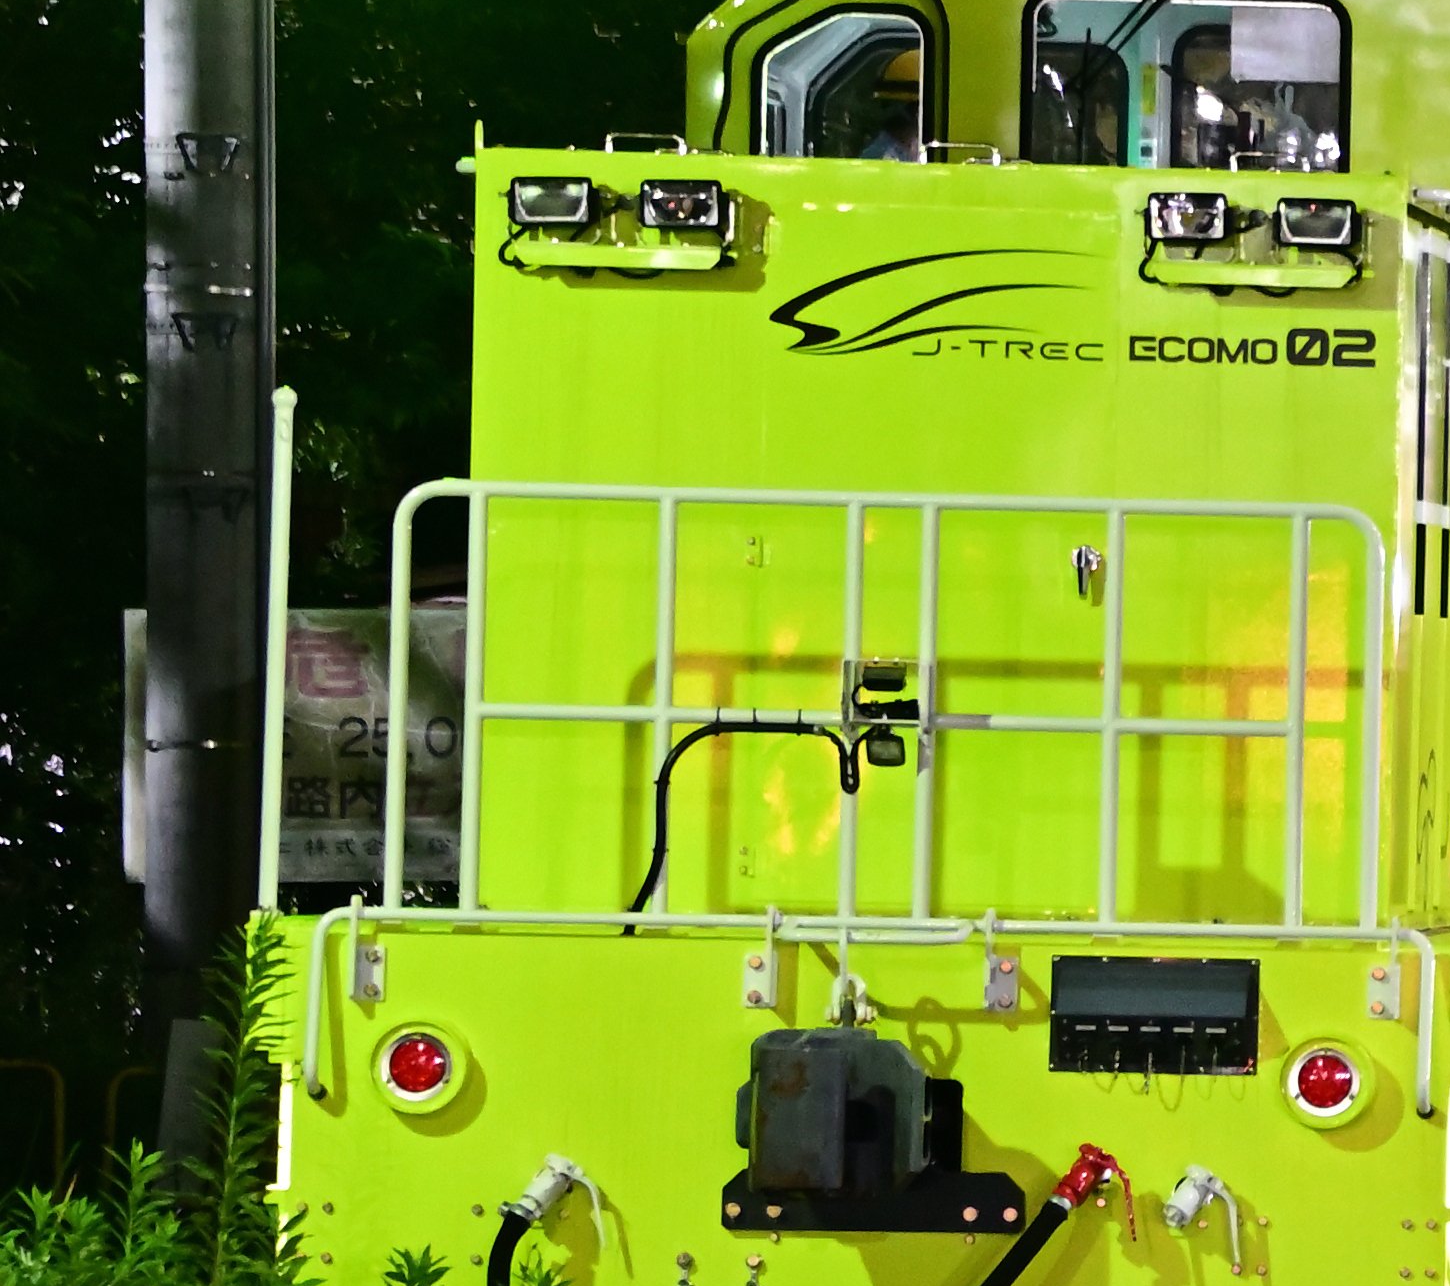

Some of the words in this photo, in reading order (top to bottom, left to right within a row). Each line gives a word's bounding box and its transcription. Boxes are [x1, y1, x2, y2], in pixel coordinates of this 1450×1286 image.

[911, 337, 1105, 363] J-TREC
[1128, 334, 1277, 365] ECOMO
[1285, 328, 1377, 369] 02
